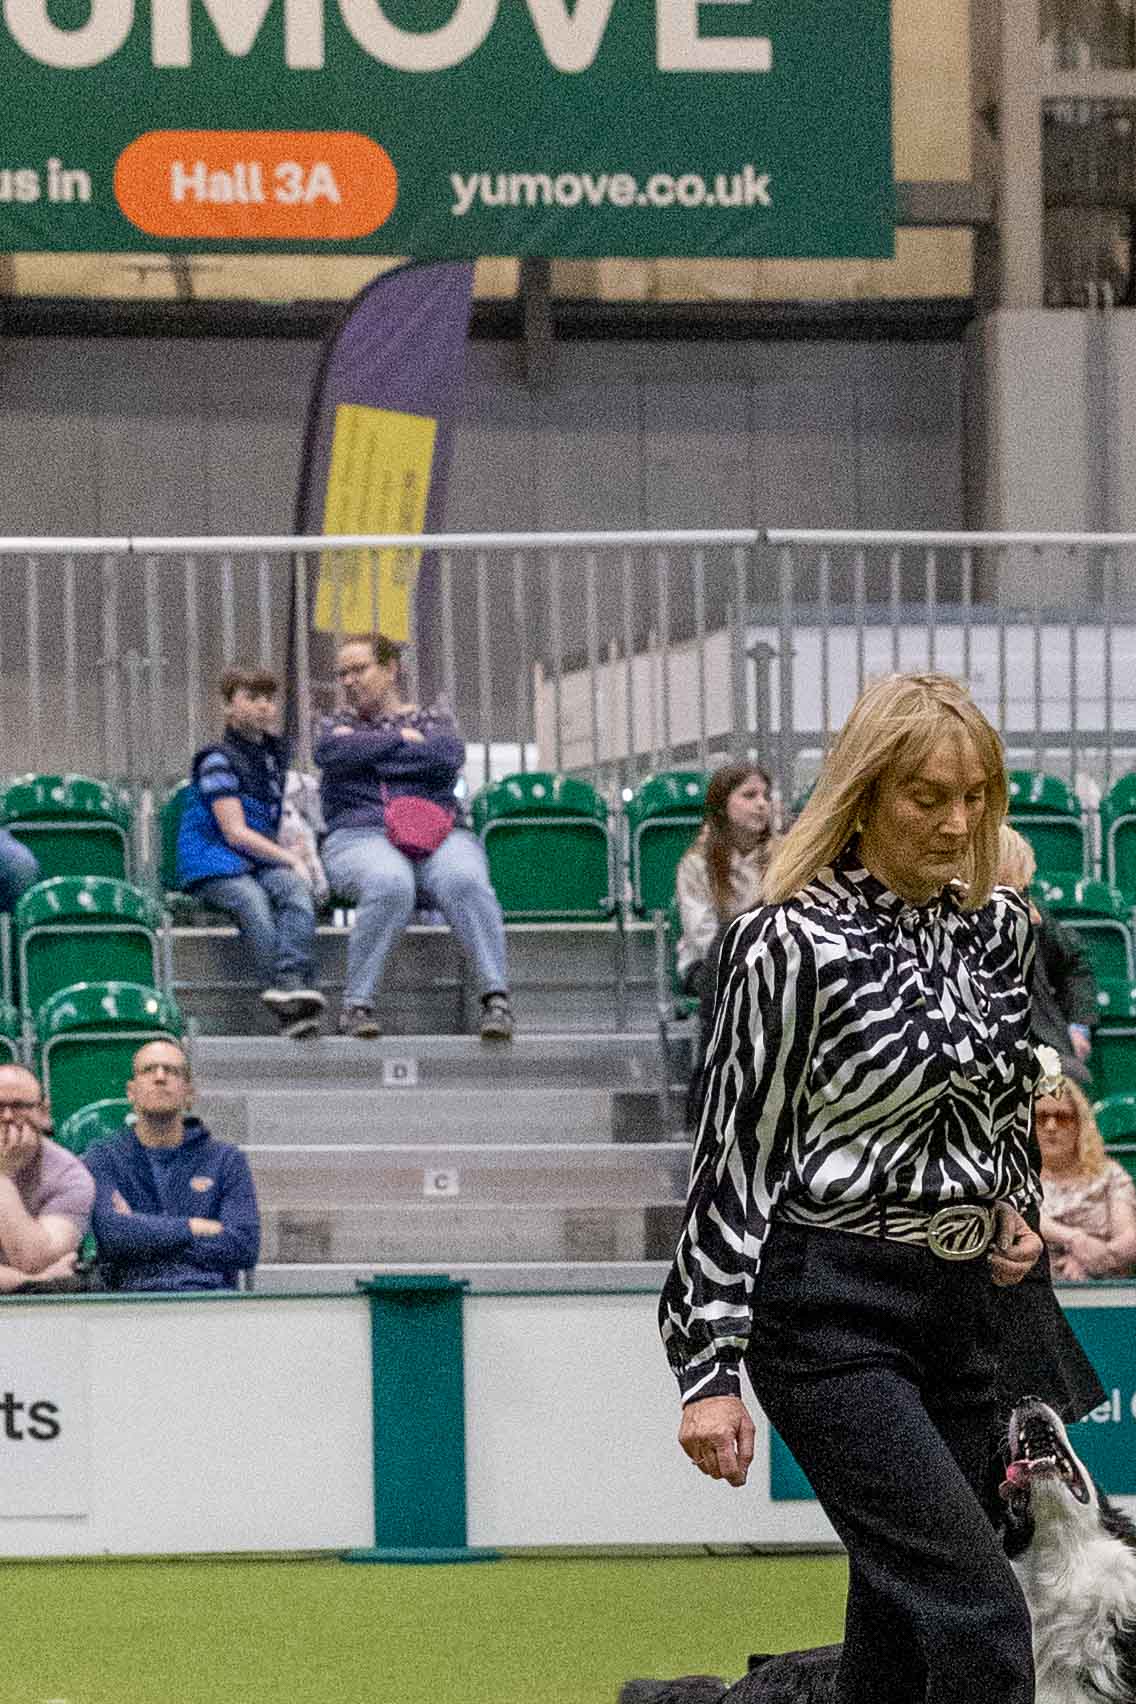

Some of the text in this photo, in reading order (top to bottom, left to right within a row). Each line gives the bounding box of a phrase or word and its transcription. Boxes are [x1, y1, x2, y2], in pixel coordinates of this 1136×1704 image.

[47, 157, 91, 202] in
[170, 161, 264, 204] Hall
[273, 161, 341, 204] 3A
[450, 163, 772, 216] yumove.co.uk
[434, 1174, 449, 1190] C
